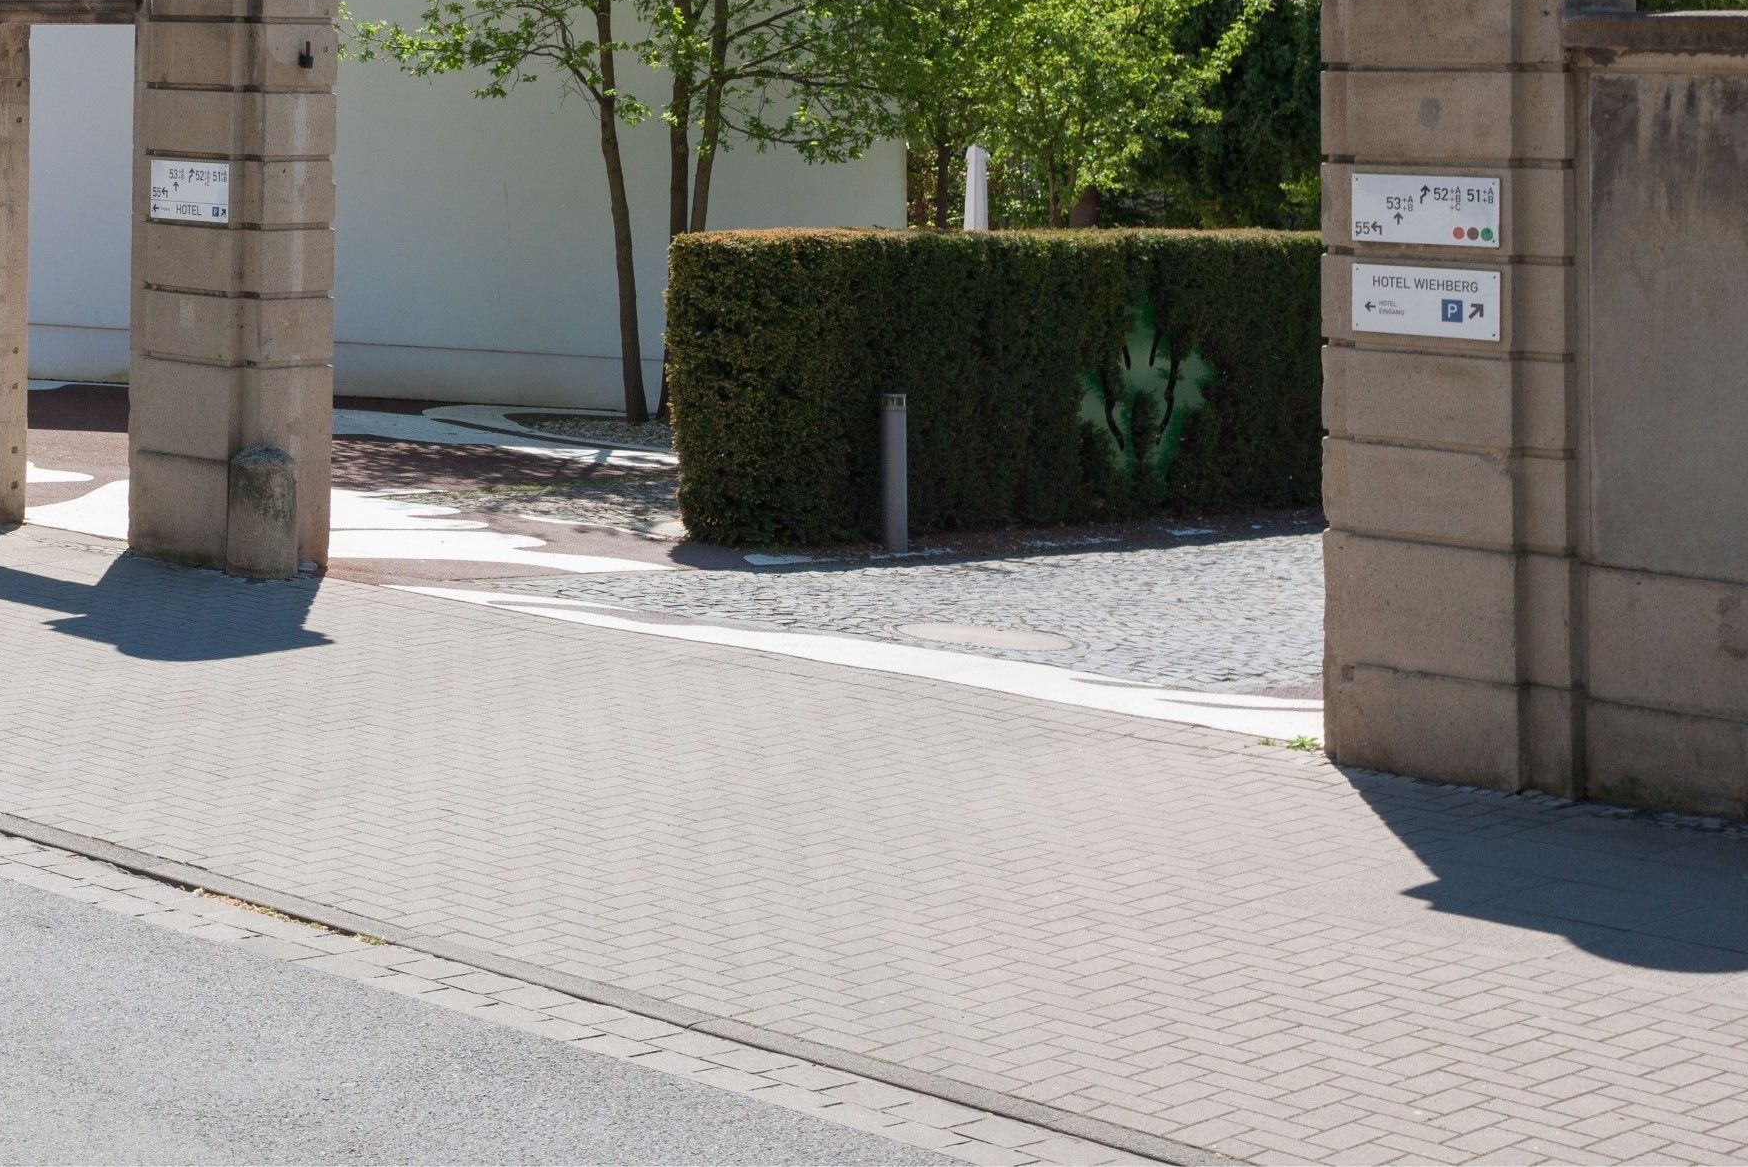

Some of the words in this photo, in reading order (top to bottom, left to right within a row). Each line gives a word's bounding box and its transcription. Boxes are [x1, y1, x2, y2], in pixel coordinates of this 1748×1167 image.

[169, 168, 178, 180] 53
[195, 170, 205, 181] 52
[212, 171, 221, 182] 51
[152, 187, 162, 198] 55
[1433, 187, 1449, 202] 52
[1467, 188, 1480, 203] 51
[176, 204, 202, 216] HOTEL
[1386, 196, 1401, 210] 53
[1355, 221, 1370, 235] 55
[1372, 275, 1410, 290] HOTEL
[1414, 278, 1479, 293] WIEHBERG
[1447, 303, 1458, 319] P
